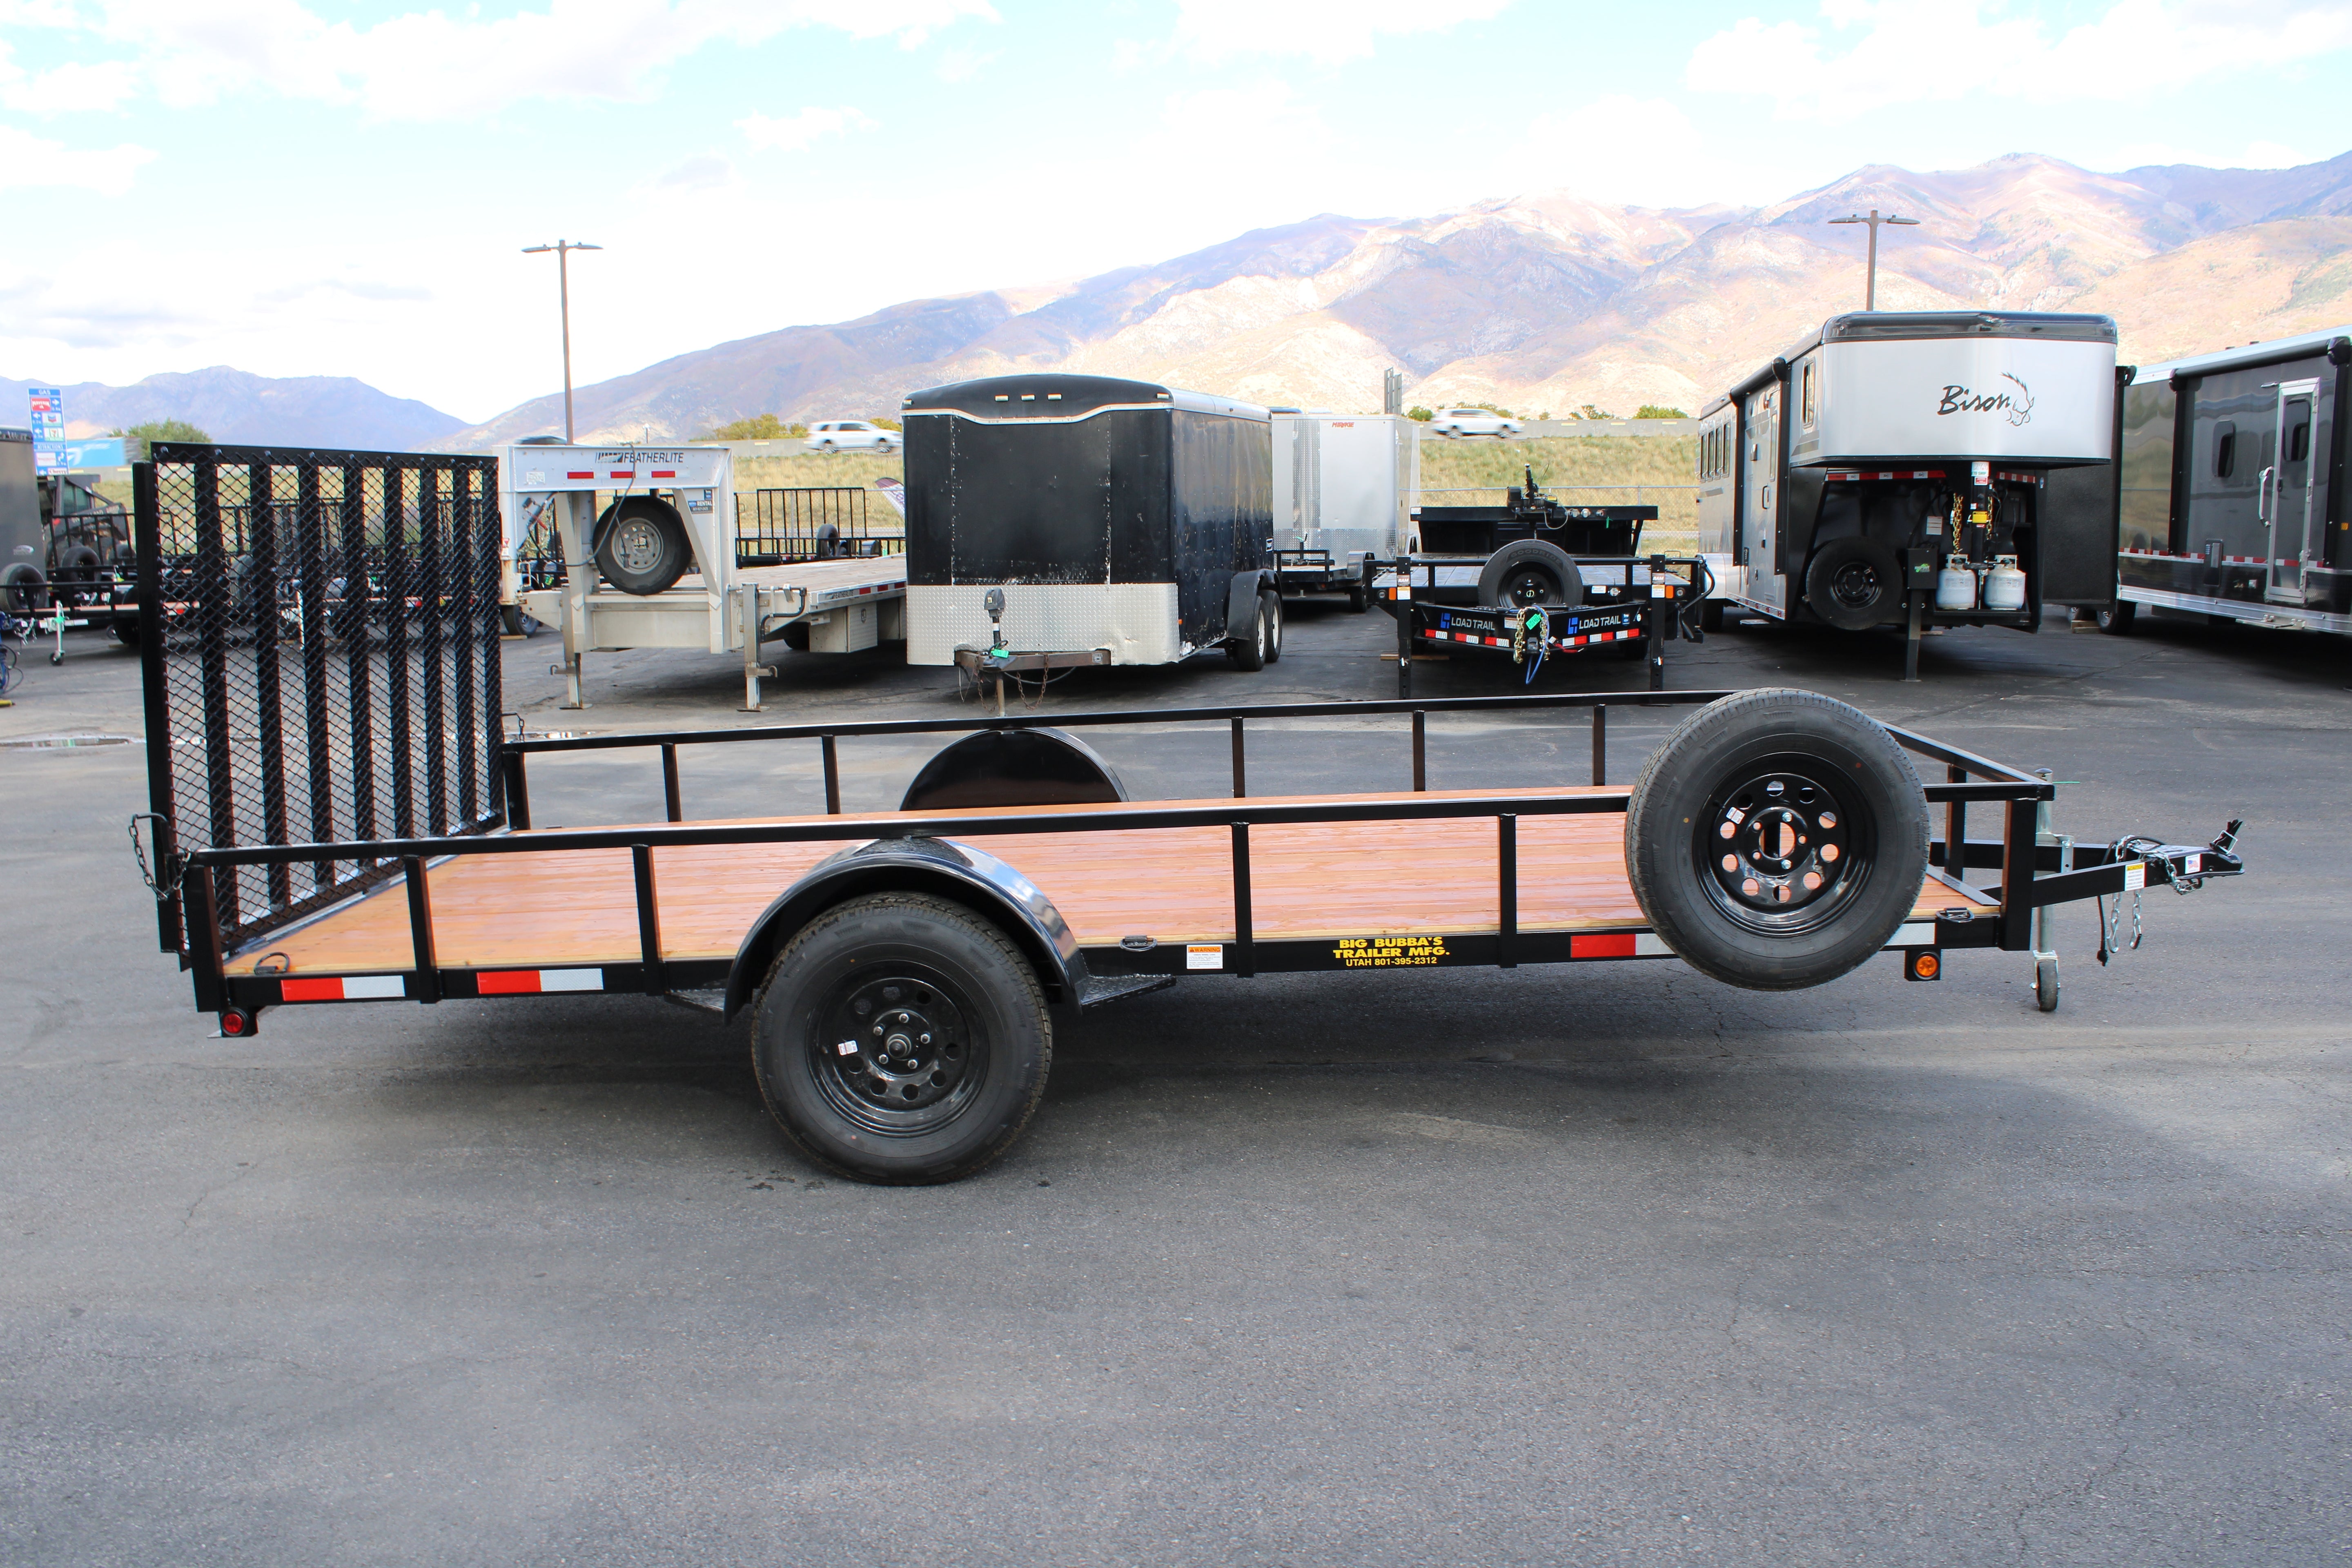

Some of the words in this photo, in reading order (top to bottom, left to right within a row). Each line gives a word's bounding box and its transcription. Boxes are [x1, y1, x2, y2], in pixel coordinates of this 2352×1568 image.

[1937, 385, 2010, 415] Bison
[624, 452, 684, 463] FEATHERLITE
[1511, 549, 1560, 564] GOODRIDE
[1339, 939, 1368, 948] BIG
[1374, 937, 1443, 947] BUBBA'S
[1333, 948, 1402, 958] TRAILER
[1408, 947, 1450, 956] MFG.
[1346, 958, 1372, 967] UTAH
[1374, 957, 1437, 965] 801-395-2312
